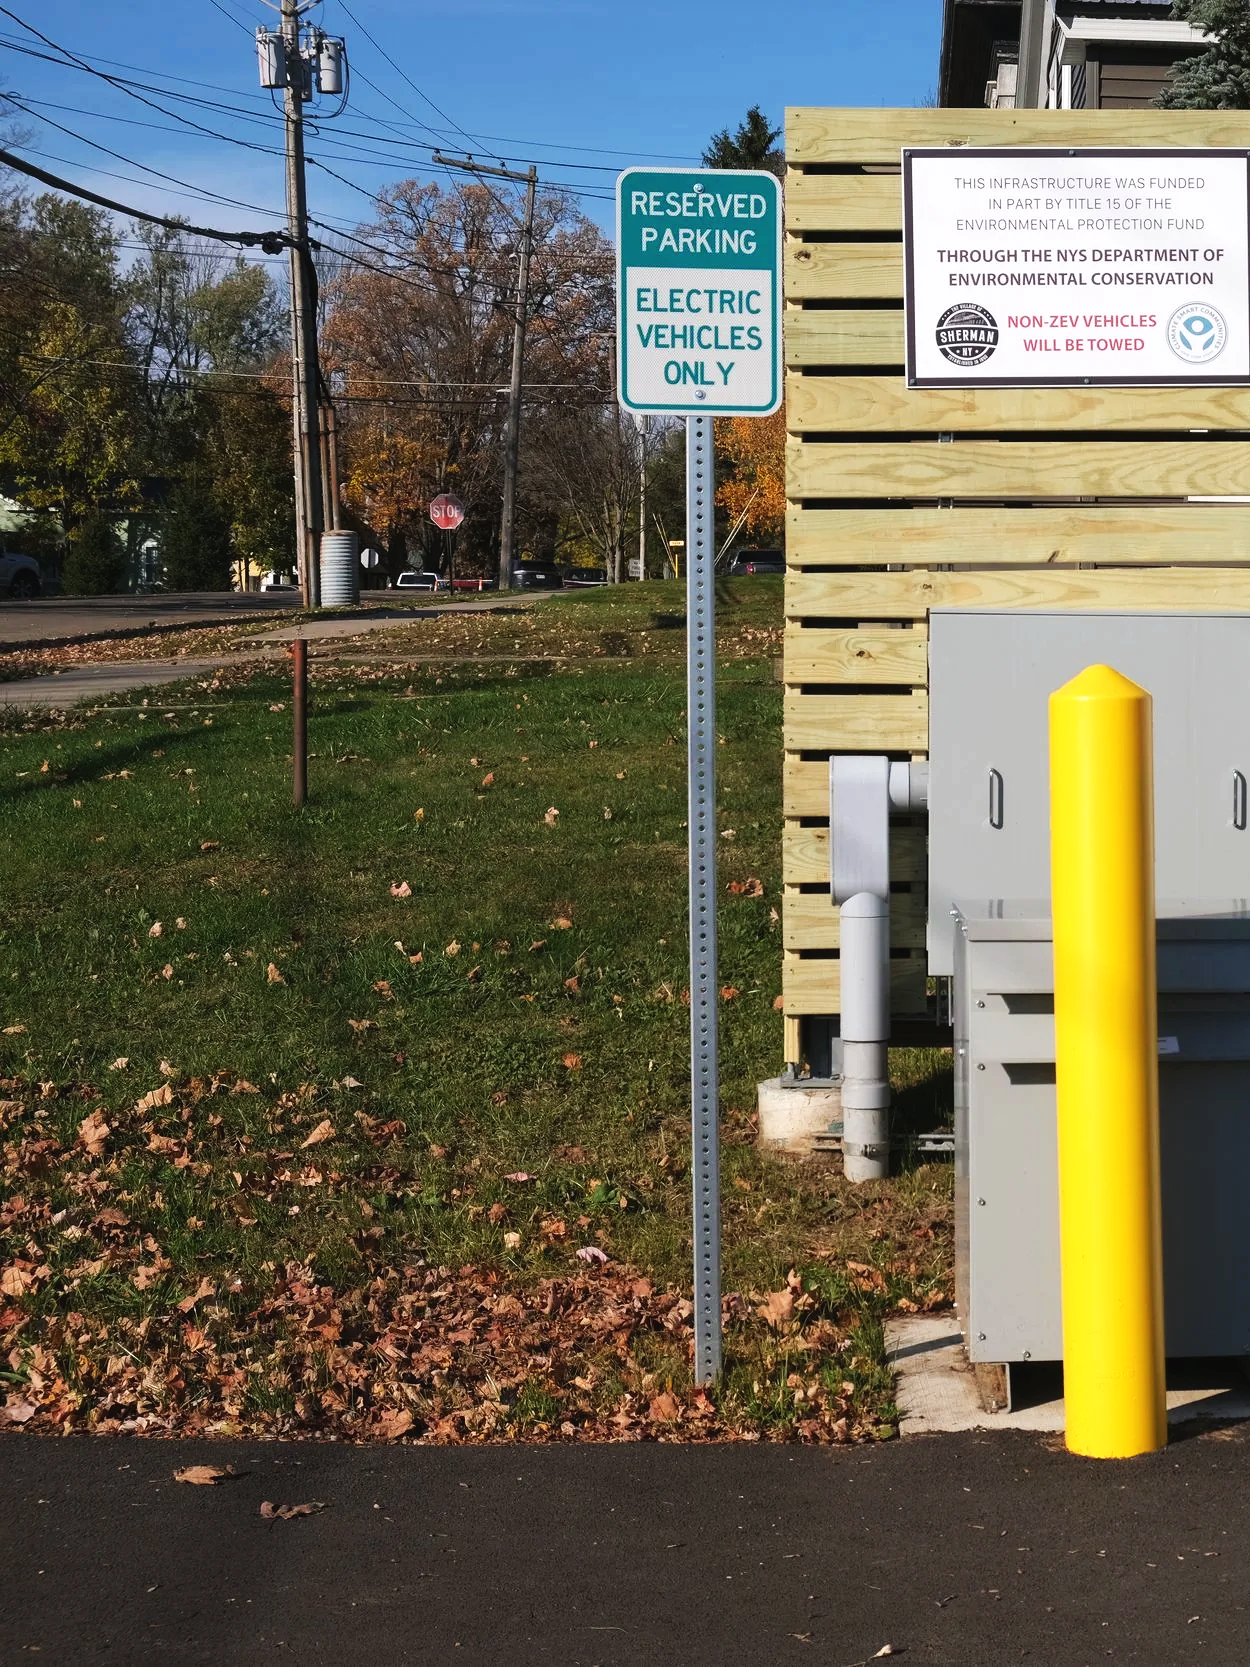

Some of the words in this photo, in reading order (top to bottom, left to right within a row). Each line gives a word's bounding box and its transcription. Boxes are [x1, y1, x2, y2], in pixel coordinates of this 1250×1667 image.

[954, 177, 985, 189] THIS
[989, 177, 1111, 189] INFRASTRUCTURE
[1116, 177, 1146, 189] WAS
[1149, 177, 1205, 189] FUNDED
[631, 191, 767, 219] RESERVED
[988, 198, 1002, 210] IN
[1006, 198, 1042, 210] PART
[1045, 198, 1063, 210] BY
[1065, 198, 1102, 210] TITLE
[1106, 198, 1121, 210] 15
[1124, 198, 1142, 210] OF
[1145, 197, 1172, 210] THE
[956, 218, 1074, 231] ENVIRONMENTAL
[1077, 218, 1163, 231] PROTECTION
[1167, 218, 1205, 230] FUND
[641, 227, 757, 255] PARKING
[937, 249, 1017, 263] THROUGH
[1021, 249, 1052, 263] THE
[1056, 249, 1088, 263] NYS
[1092, 248, 1199, 262] DEPARTMENT
[1203, 248, 1225, 262] OF
[948, 272, 1087, 287] ENVIRONMENTAL
[1091, 271, 1214, 286] CONSERVATION
[636, 287, 762, 315] ELECTRIC
[1008, 315, 1080, 329] NON-ZEV
[1083, 314, 1157, 328] VEHICLES
[1171, 320, 1181, 350] CLIMATE
[1176, 306, 1198, 320] SMART
[1200, 307, 1224, 350] COMMUNITIES
[636, 323, 763, 351] VEHICLES
[939, 329, 995, 343] SHERMAN
[962, 347, 973, 357] NY
[1023, 338, 1062, 352] WILL
[1065, 338, 1085, 352] BE
[1087, 338, 1145, 352] TOWED
[663, 359, 735, 386] ONLY
[432, 504, 461, 518] STOP
